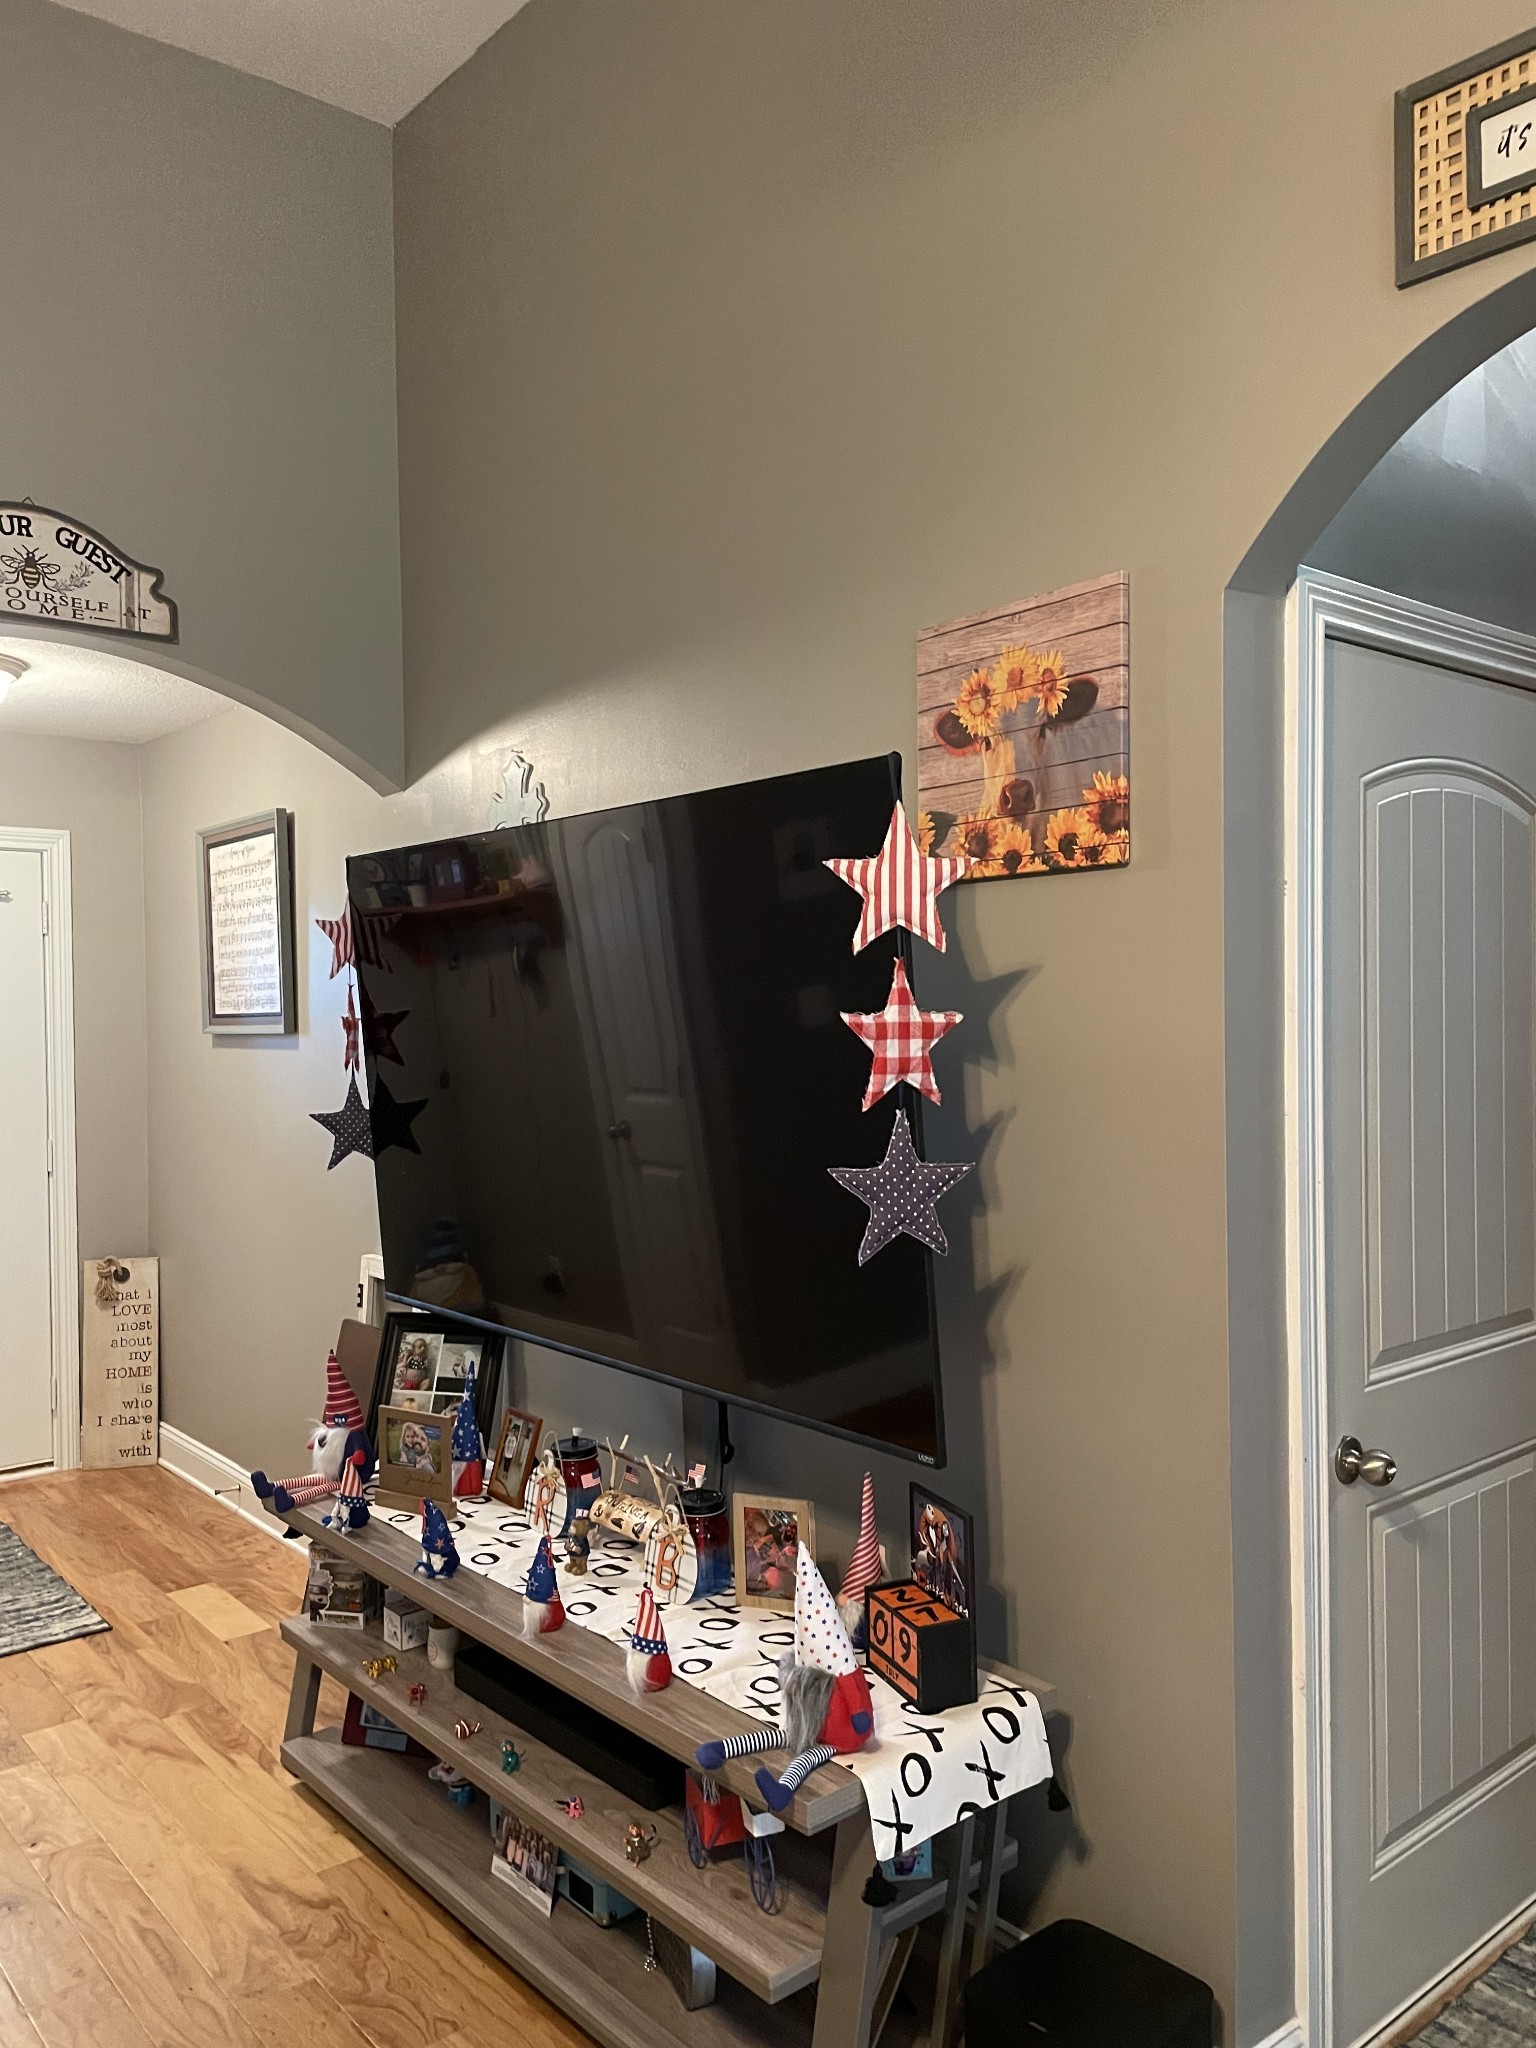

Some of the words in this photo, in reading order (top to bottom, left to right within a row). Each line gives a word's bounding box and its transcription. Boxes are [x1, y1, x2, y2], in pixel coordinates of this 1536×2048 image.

[55, 527, 132, 584] GUEST
[123, 606, 152, 620] AT
[112, 1303, 152, 1316] LOVE
[116, 1319, 153, 1332] most
[110, 1336, 152, 1348] about
[128, 1350, 152, 1362] my
[105, 1366, 152, 1379] HOME
[139, 1383, 152, 1394] is
[122, 1398, 153, 1409] who
[97, 1416, 103, 1427] I
[110, 1414, 153, 1427] share
[141, 1430, 152, 1440] it
[118, 1445, 152, 1458] with
[981, 1706, 1021, 1744] O
[900, 1752, 932, 1798] O
[964, 1739, 1006, 1801] X
